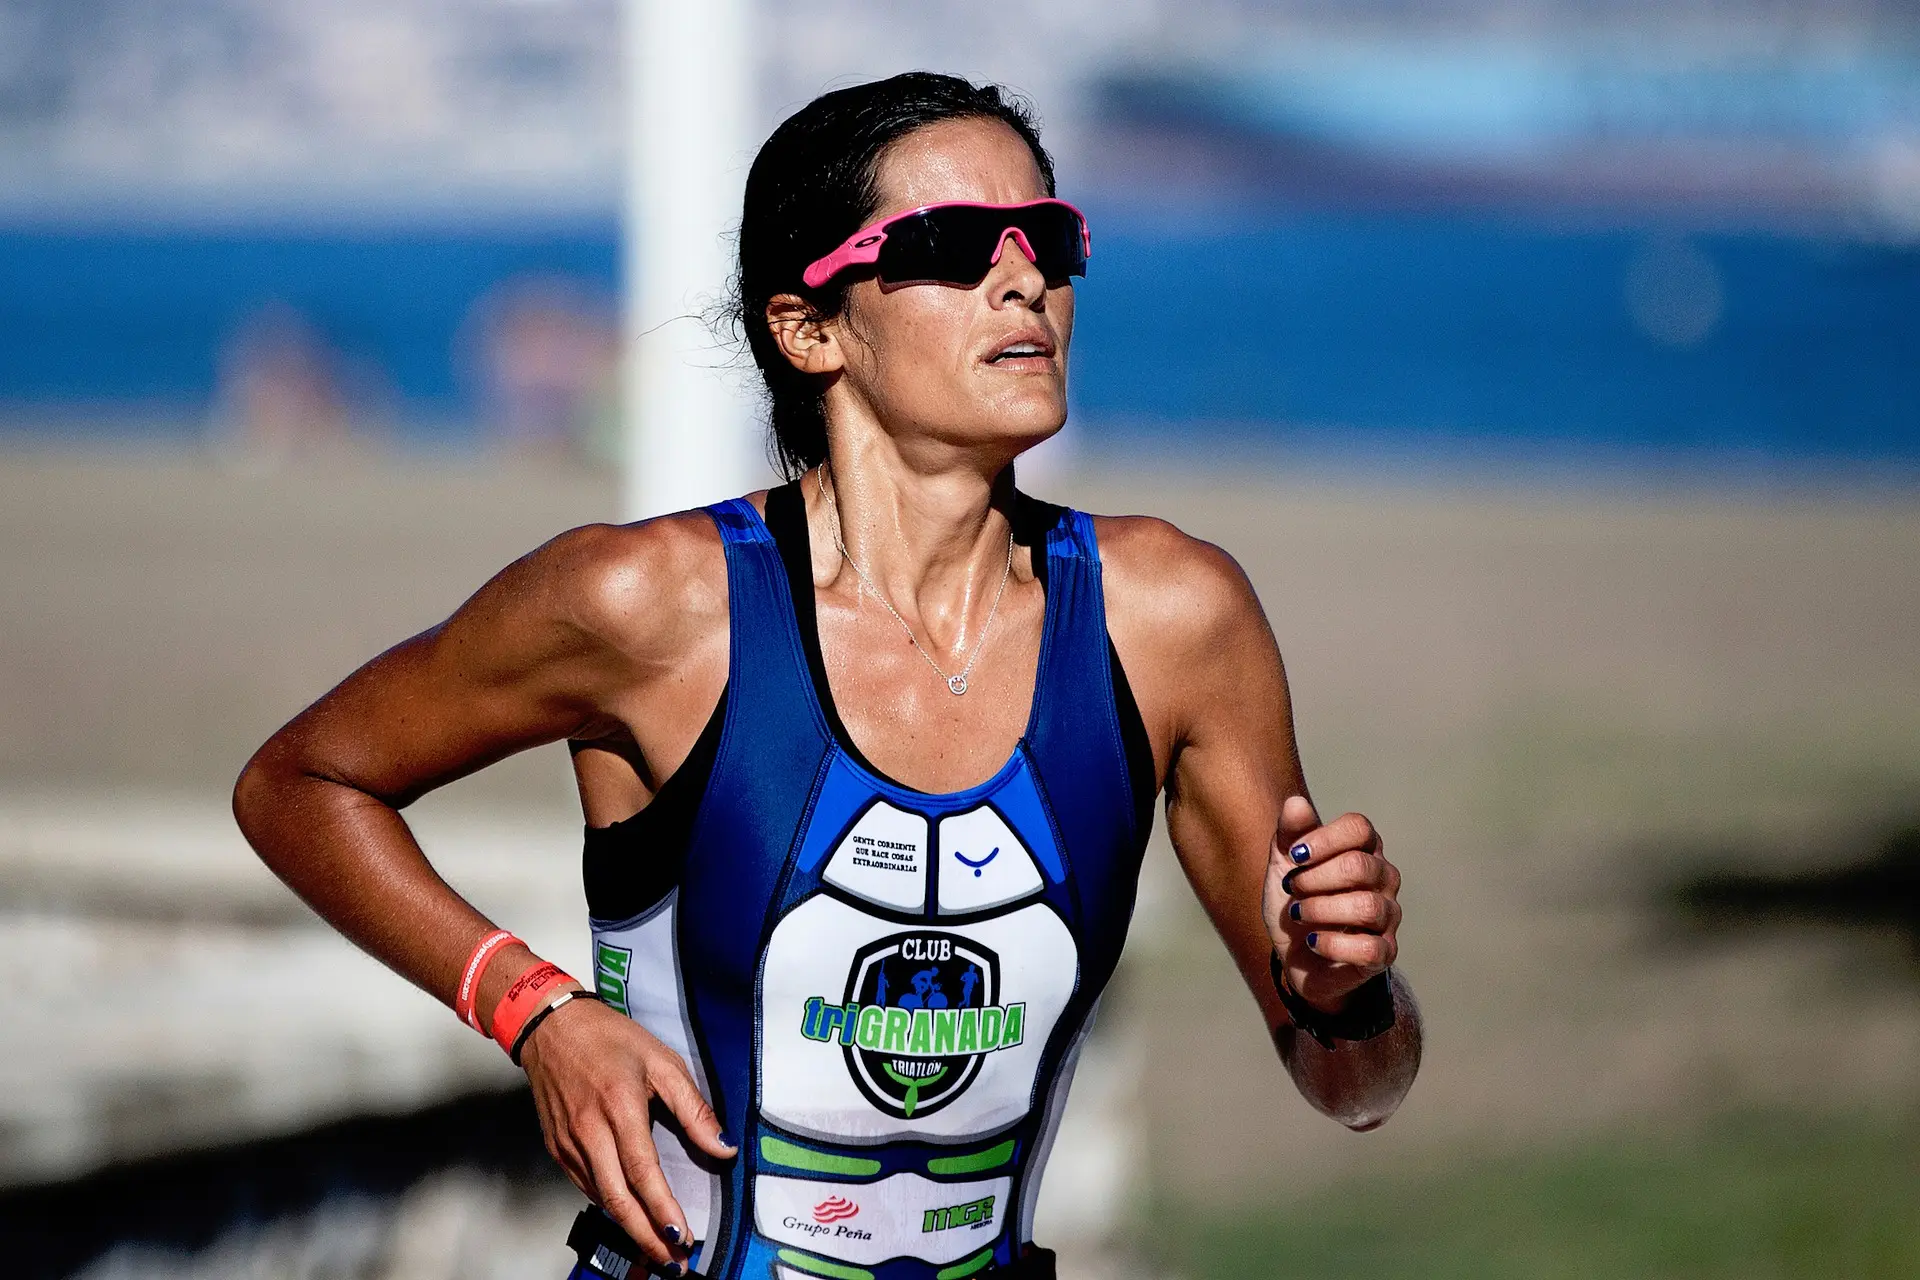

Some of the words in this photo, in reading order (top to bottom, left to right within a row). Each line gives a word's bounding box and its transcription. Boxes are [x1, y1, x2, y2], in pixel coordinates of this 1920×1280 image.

[852, 836, 875, 846] GENTE
[877, 840, 916, 852] CORRIENTE
[855, 847, 869, 856] QUE
[871, 850, 889, 859] HACE
[891, 853, 913, 862] COSAS
[852, 857, 917, 872] EXTRAORDINARIAS
[902, 938, 951, 961] CLUB
[782, 1215, 831, 1238] Grupo
[834, 1224, 872, 1240] Peña
